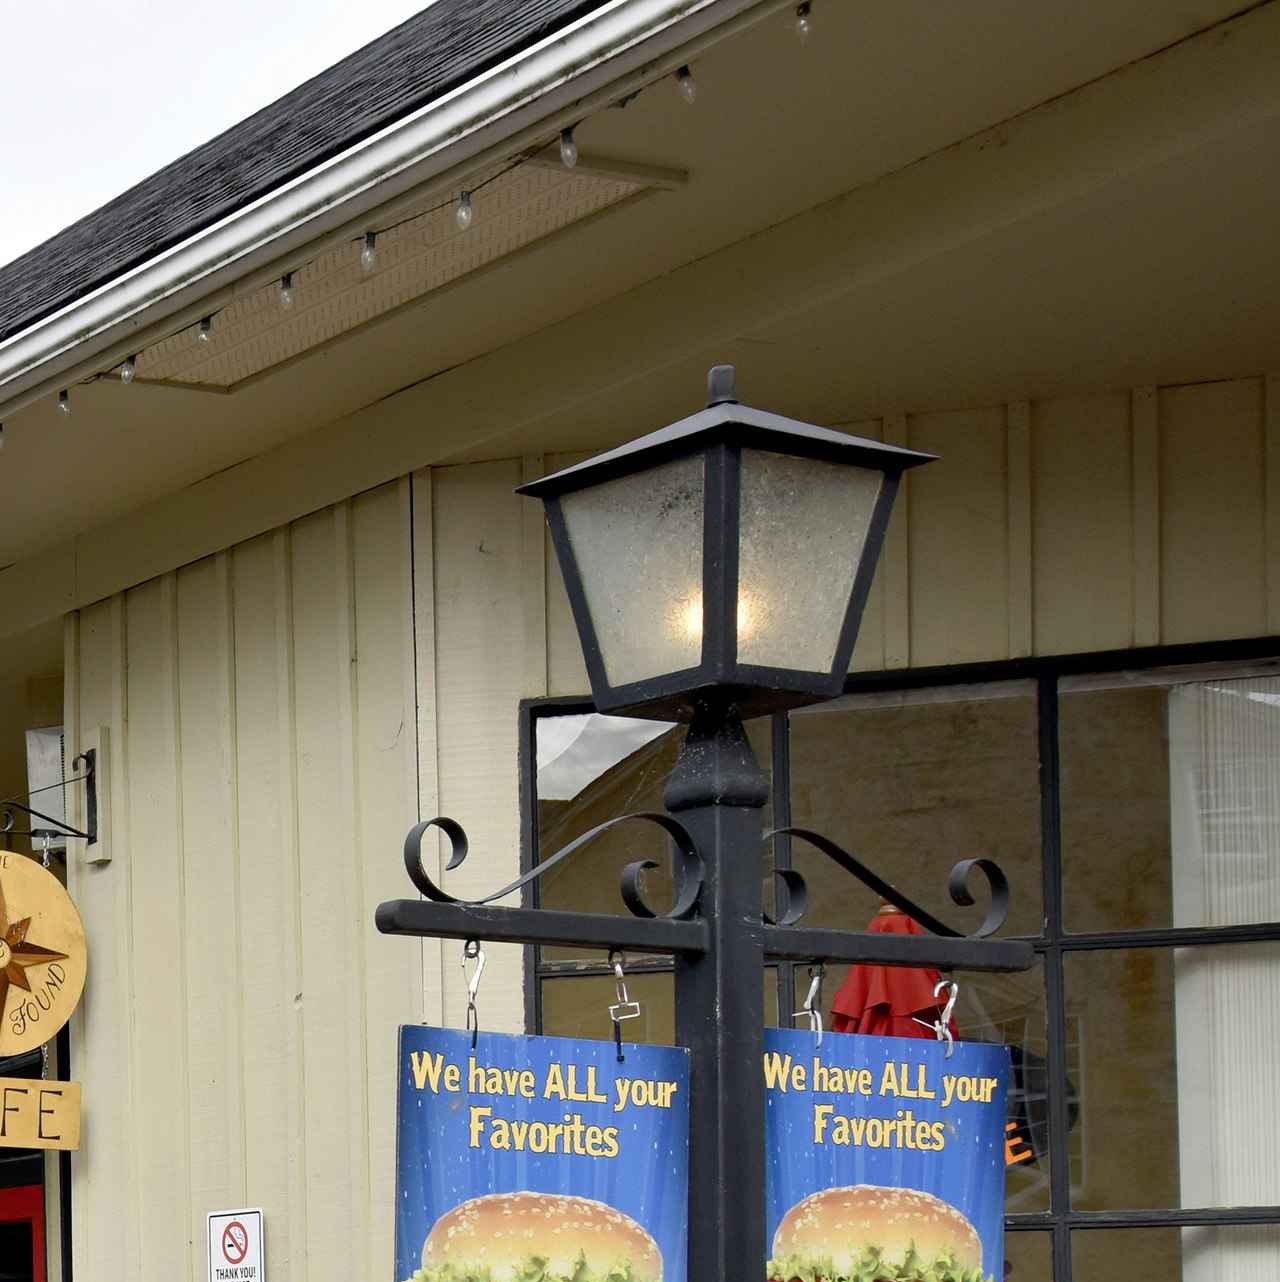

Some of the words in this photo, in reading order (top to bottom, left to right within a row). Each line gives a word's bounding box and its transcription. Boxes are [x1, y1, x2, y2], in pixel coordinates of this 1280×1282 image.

[9, 963, 66, 1036] FOUND
[410, 1050, 461, 1094] We
[468, 1056, 536, 1098] have
[543, 1063, 608, 1103] ALL
[613, 1077, 678, 1112] your
[763, 1052, 807, 1093] We
[813, 1056, 873, 1095] have
[879, 1062, 935, 1099] ALL
[941, 1075, 998, 1107] your
[469, 1105, 619, 1158] Favorites
[813, 1104, 945, 1152] Favorites
[216, 1267, 239, 1280] THANK
[240, 1266, 256, 1279] YOU!
